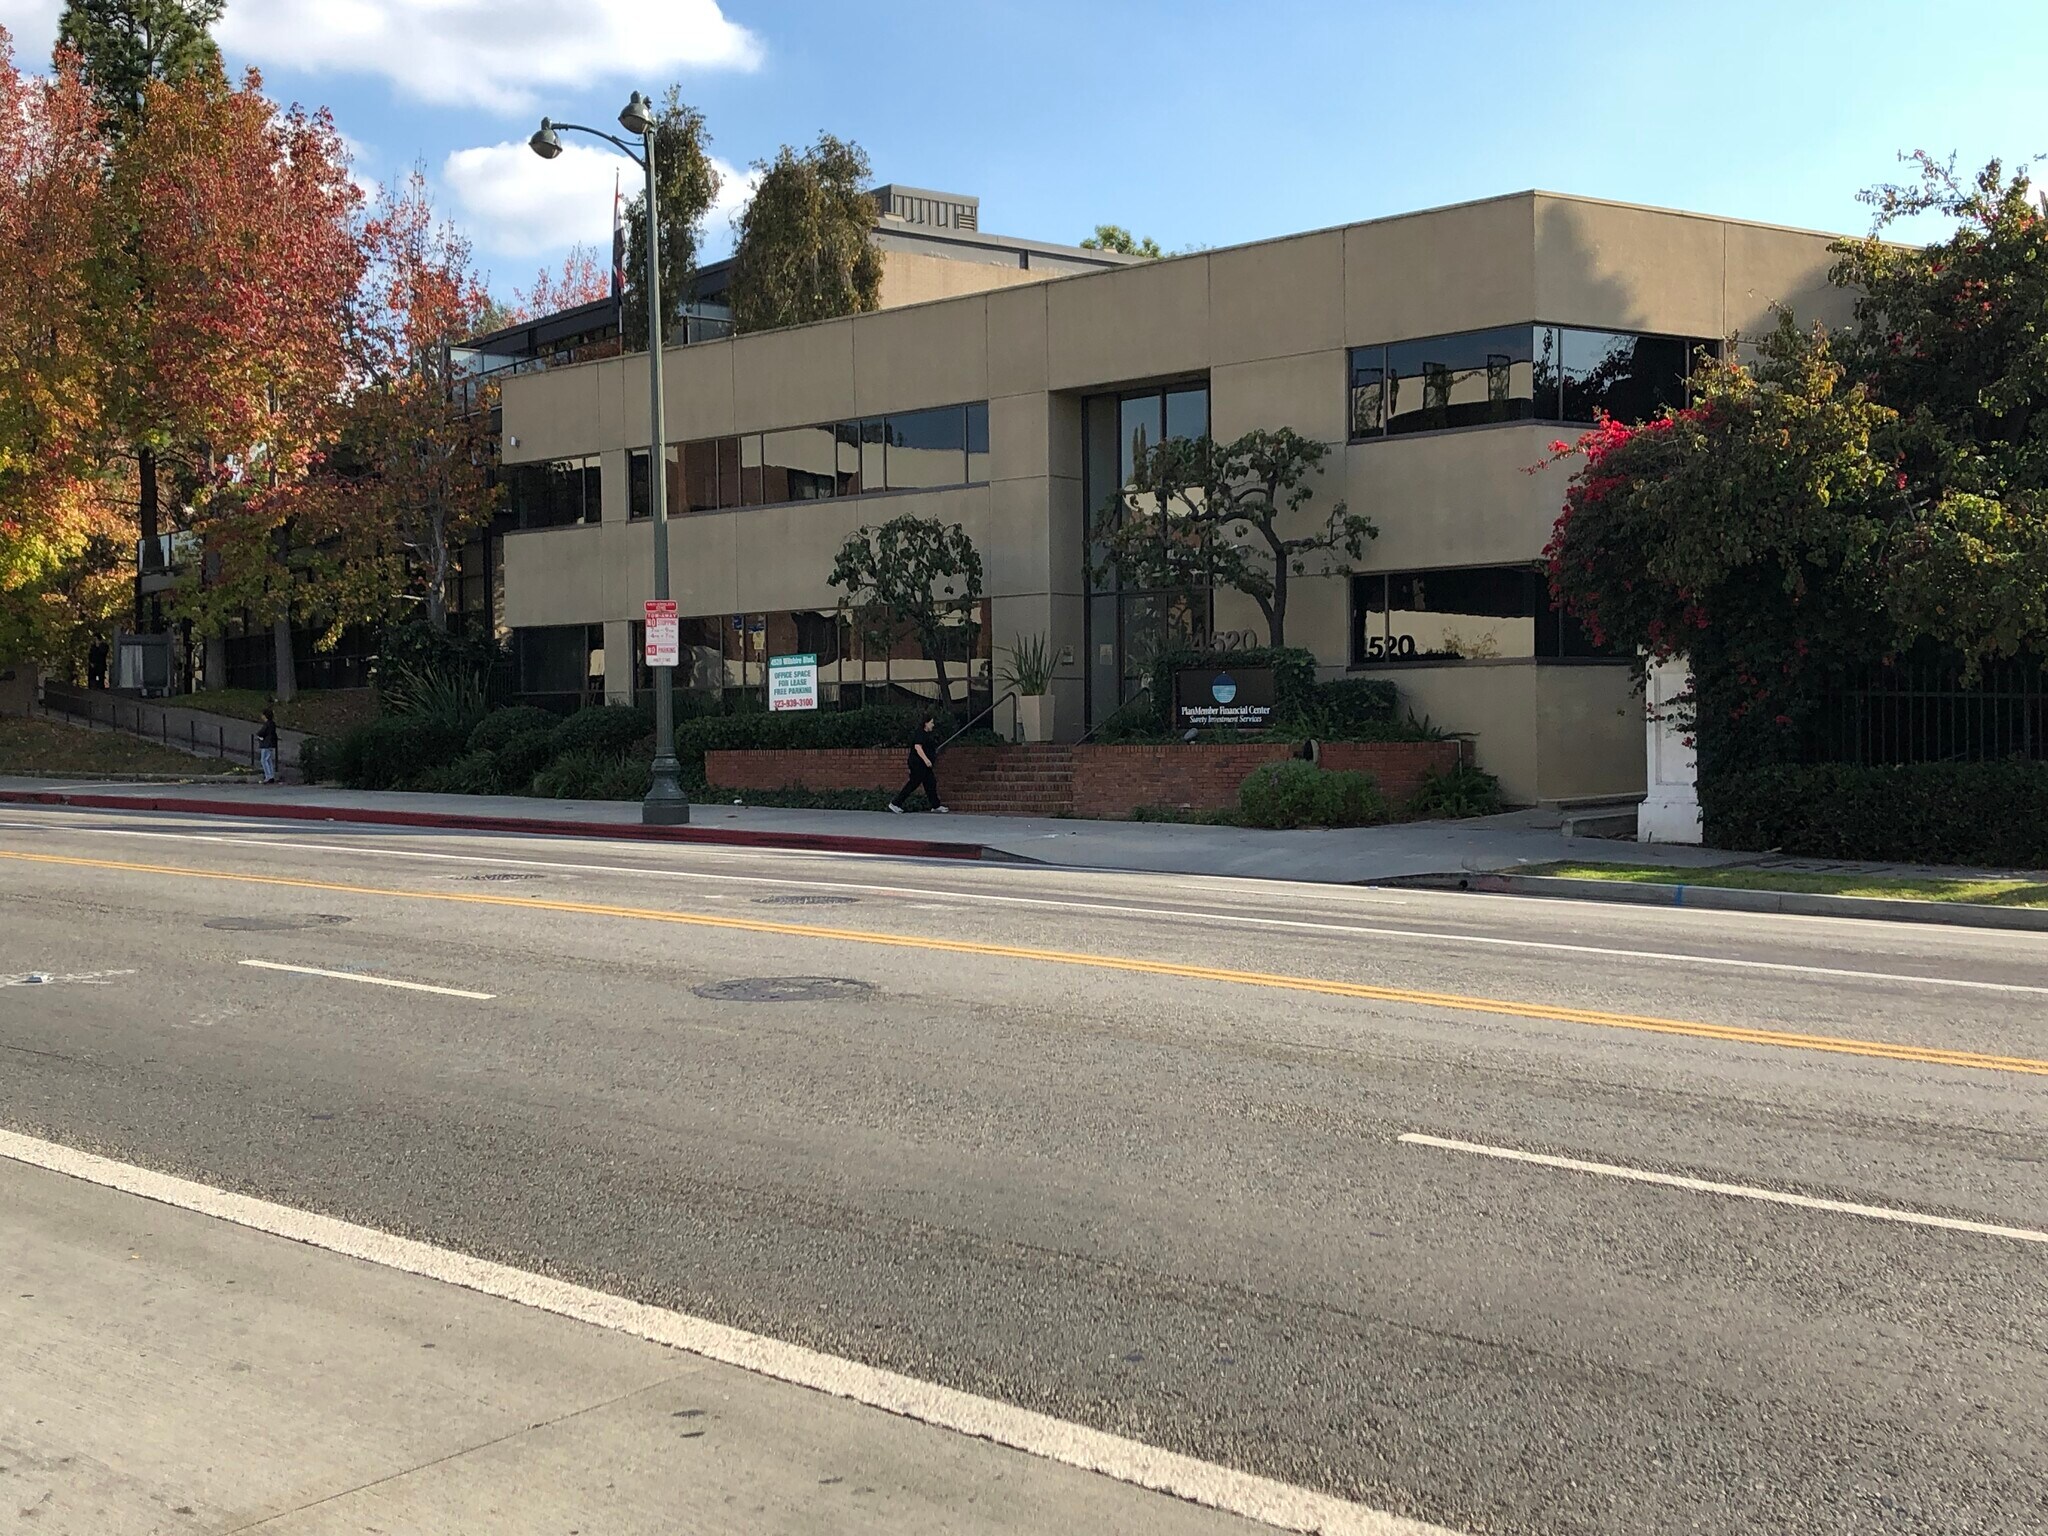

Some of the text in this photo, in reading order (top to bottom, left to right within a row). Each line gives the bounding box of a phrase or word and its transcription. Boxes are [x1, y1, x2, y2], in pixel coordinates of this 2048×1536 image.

[647, 618, 656, 626] NO
[647, 646, 656, 655] NO
[794, 670, 811, 678] SPACE
[790, 678, 807, 686] LEASE
[1181, 706, 1270, 715] PlanMember Financial Center
[1240, 715, 1262, 723] Services
